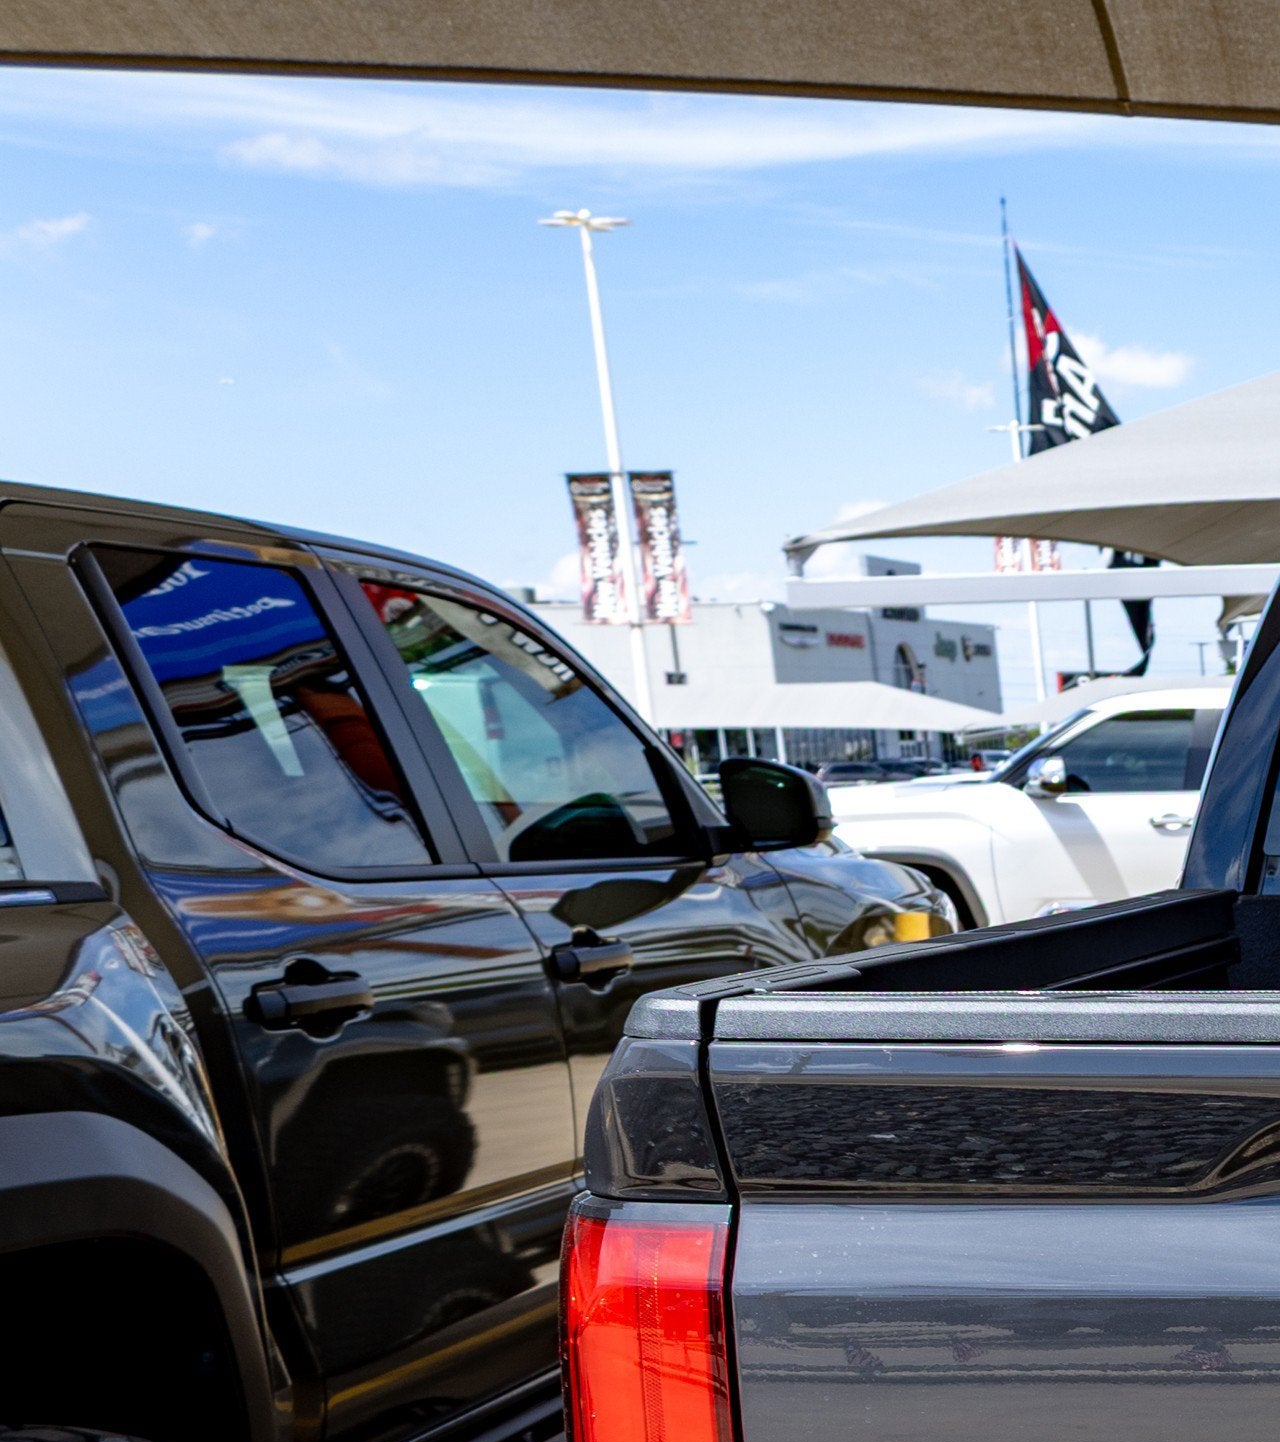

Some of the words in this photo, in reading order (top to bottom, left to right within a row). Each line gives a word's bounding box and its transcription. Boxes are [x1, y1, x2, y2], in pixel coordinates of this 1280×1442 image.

[587, 507, 613, 579] Vehicles
[647, 506, 674, 579] Vehicles
[592, 579, 617, 618] New
[656, 578, 679, 618] New
